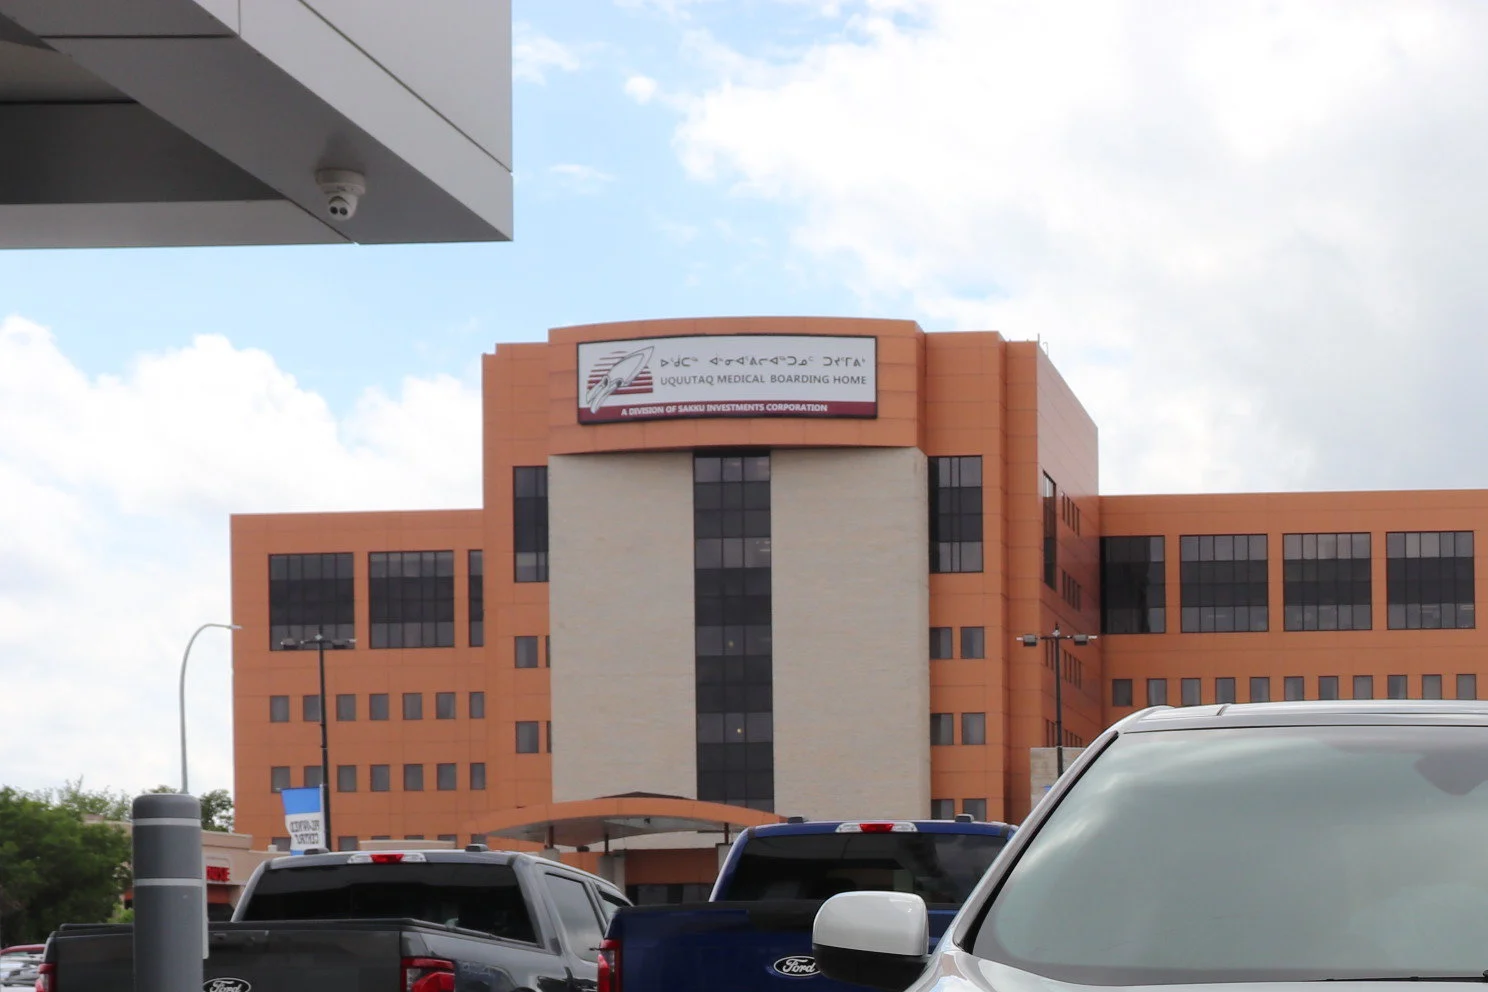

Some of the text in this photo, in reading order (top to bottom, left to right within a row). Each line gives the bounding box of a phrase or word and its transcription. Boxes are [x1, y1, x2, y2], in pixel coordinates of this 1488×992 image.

[660, 374, 867, 387] UQUUTAQ MEDICAL BOARDING HOME
[621, 403, 828, 416] A DIVISION OF SAKKU INVESTMENTS CORPORATION
[782, 957, 817, 974] Ford
